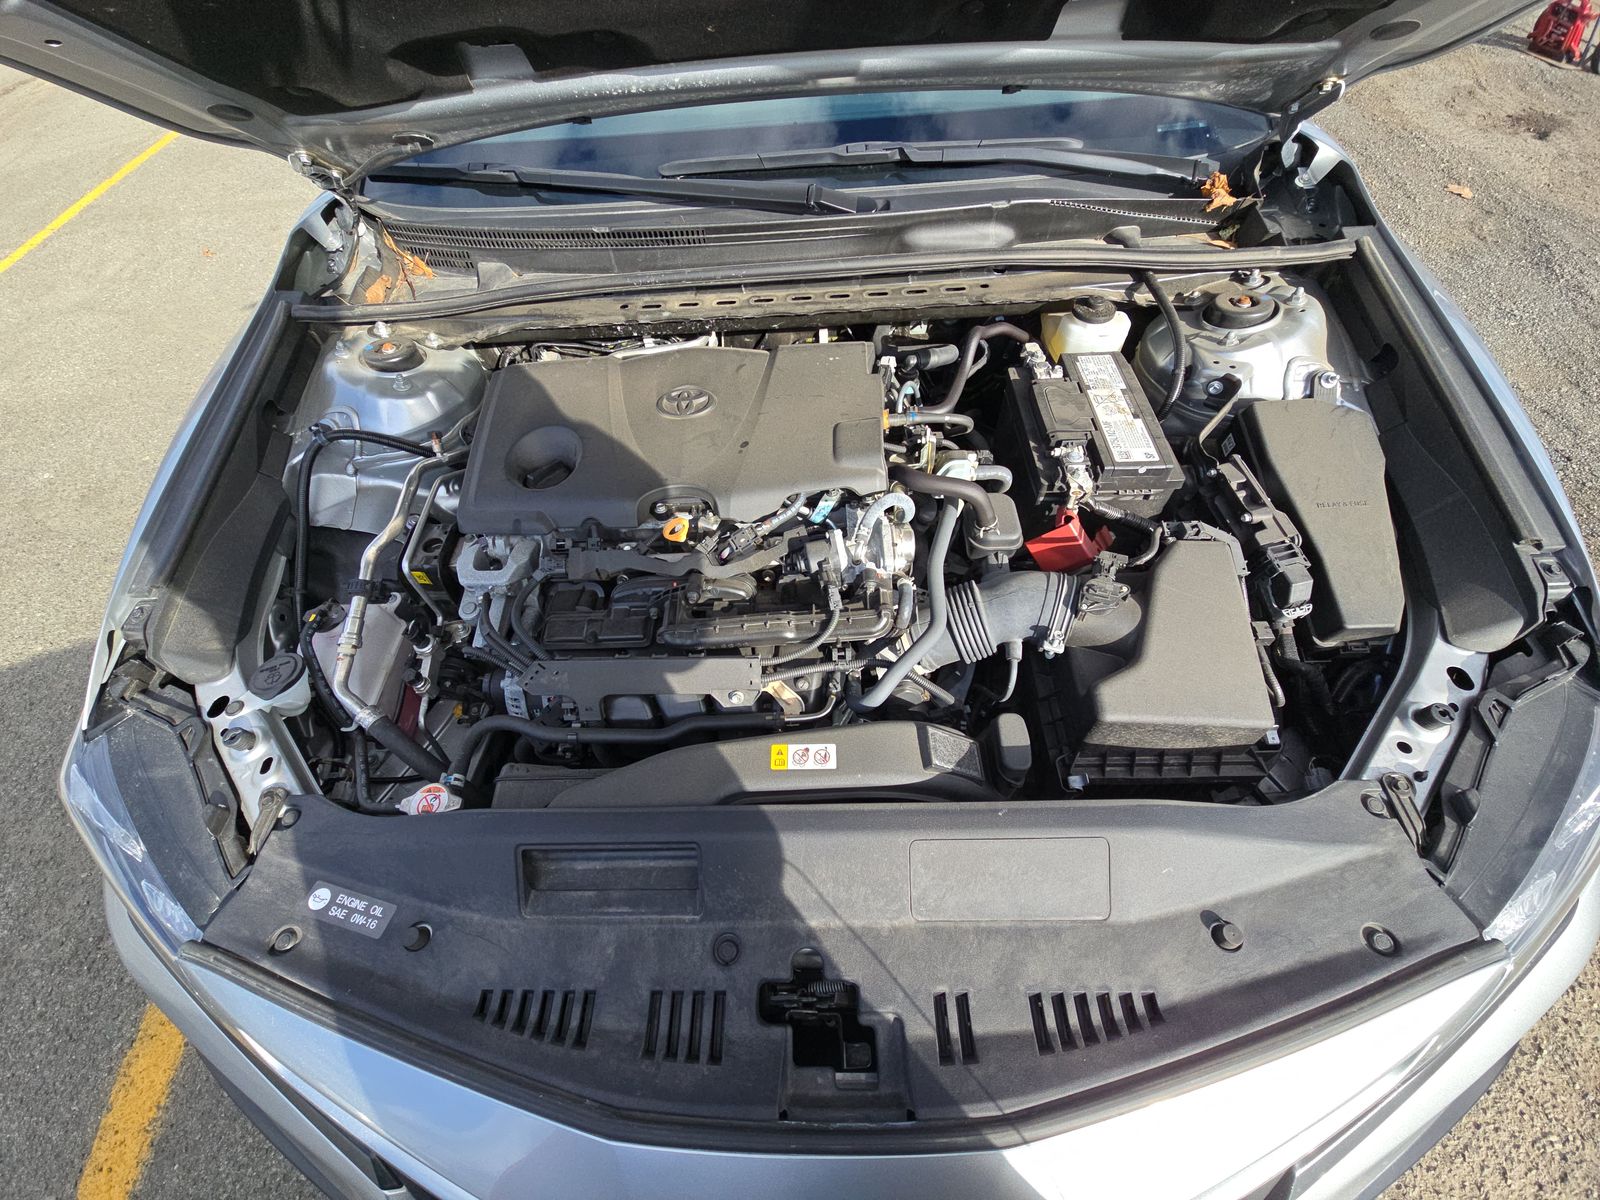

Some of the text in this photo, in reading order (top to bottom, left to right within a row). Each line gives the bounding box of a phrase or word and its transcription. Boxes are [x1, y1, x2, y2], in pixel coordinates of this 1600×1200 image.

[1315, 501, 1341, 509] RELAY
[336, 894, 384, 917] ENGINE OIL
[328, 906, 378, 930] SAE 0W-16
